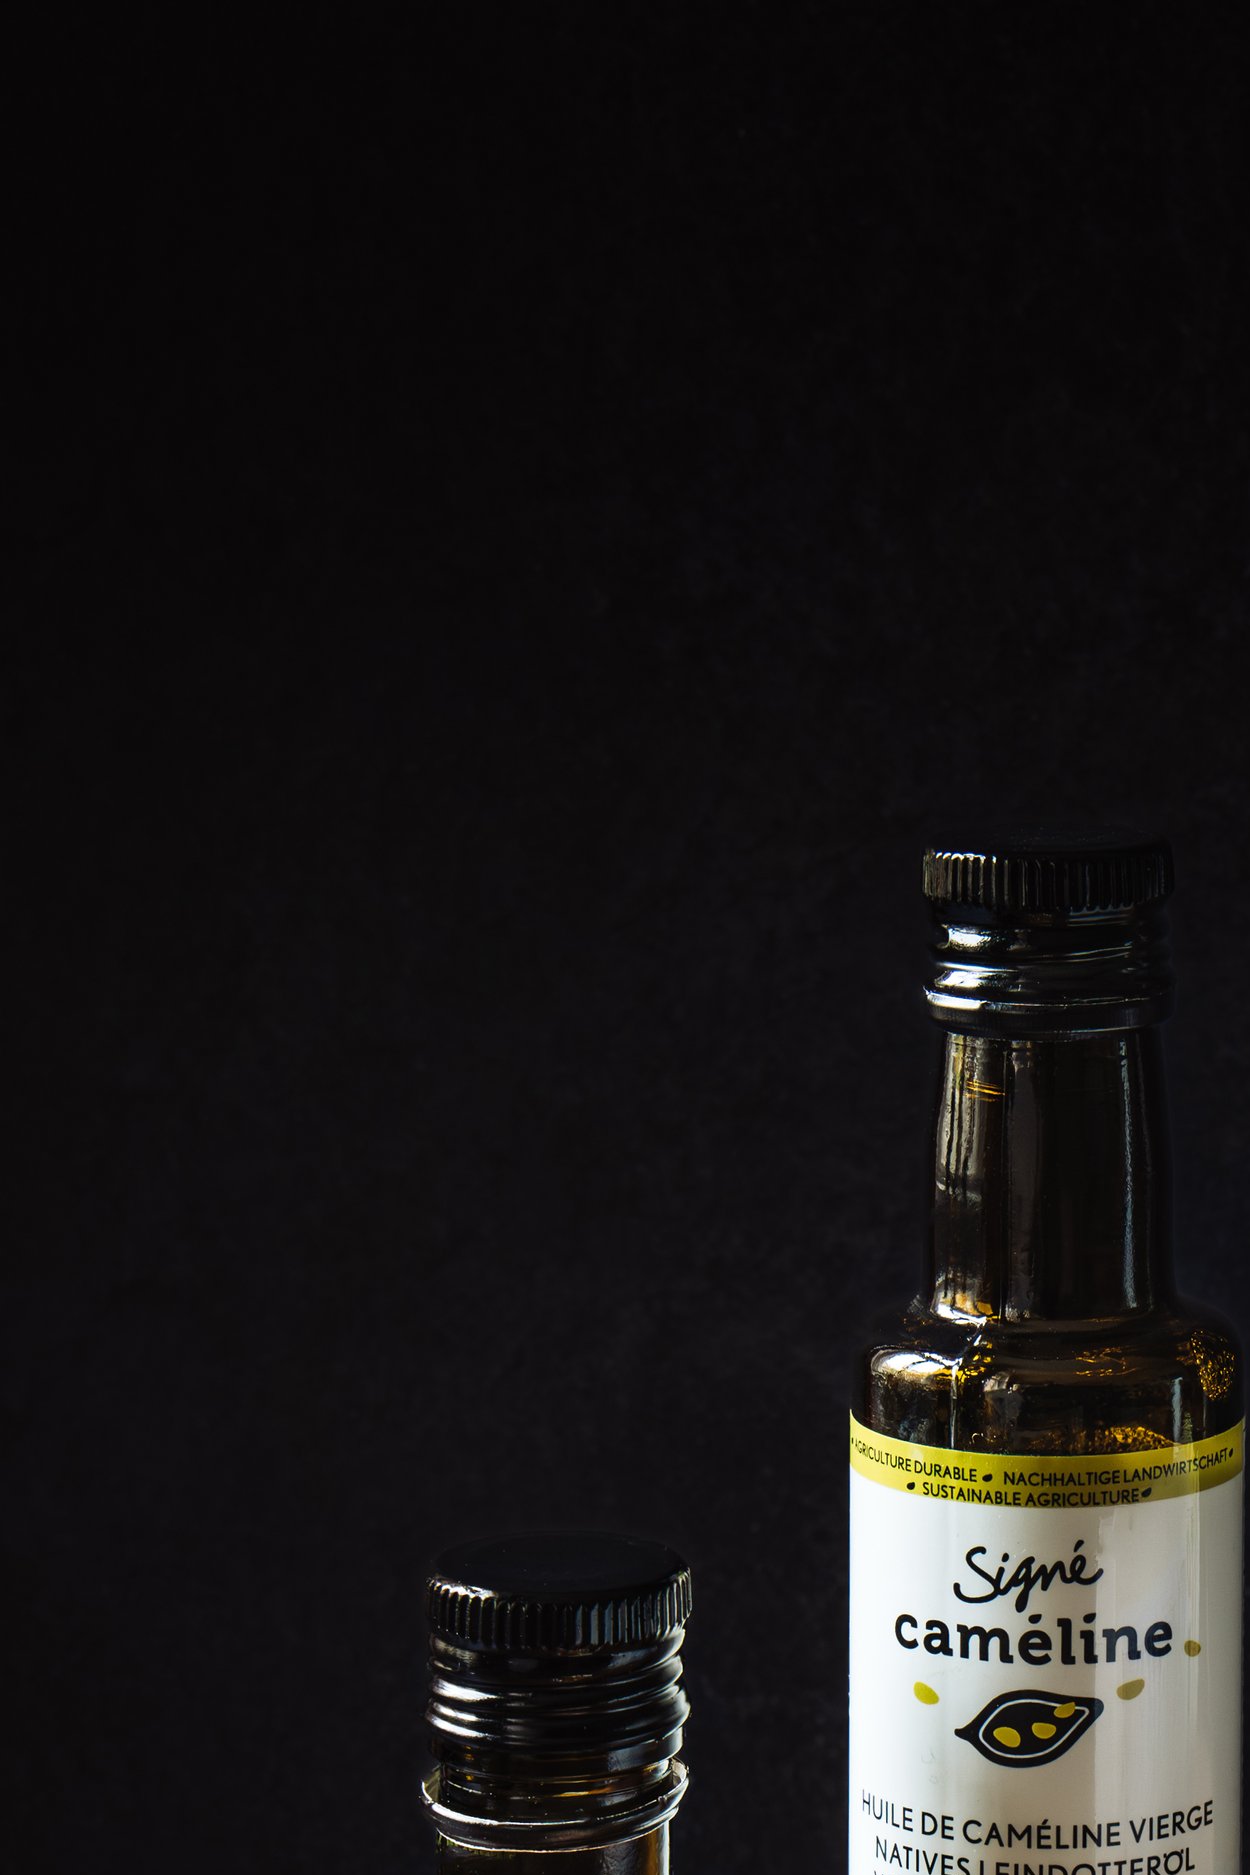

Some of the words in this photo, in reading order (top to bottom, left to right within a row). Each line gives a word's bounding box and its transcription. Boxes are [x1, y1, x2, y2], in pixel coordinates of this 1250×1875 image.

[855, 1438, 912, 1473] AGRICULTURE
[914, 1460, 978, 1483] DURABLE
[1003, 1470, 1121, 1487] NACHHALTIGE
[1122, 1448, 1229, 1484] LANDWIRTSCHAFT
[922, 1482, 1021, 1507] SUSTAINABLE
[1024, 1488, 1140, 1508] AGRICULTURE
[953, 1539, 1104, 1613] Signé
[894, 1612, 1173, 1666] caméline
[862, 1789, 914, 1833] HUILE
[921, 1811, 955, 1841] DE
[962, 1818, 1121, 1850] CAMÉLINE
[1129, 1800, 1214, 1843] VIERGE
